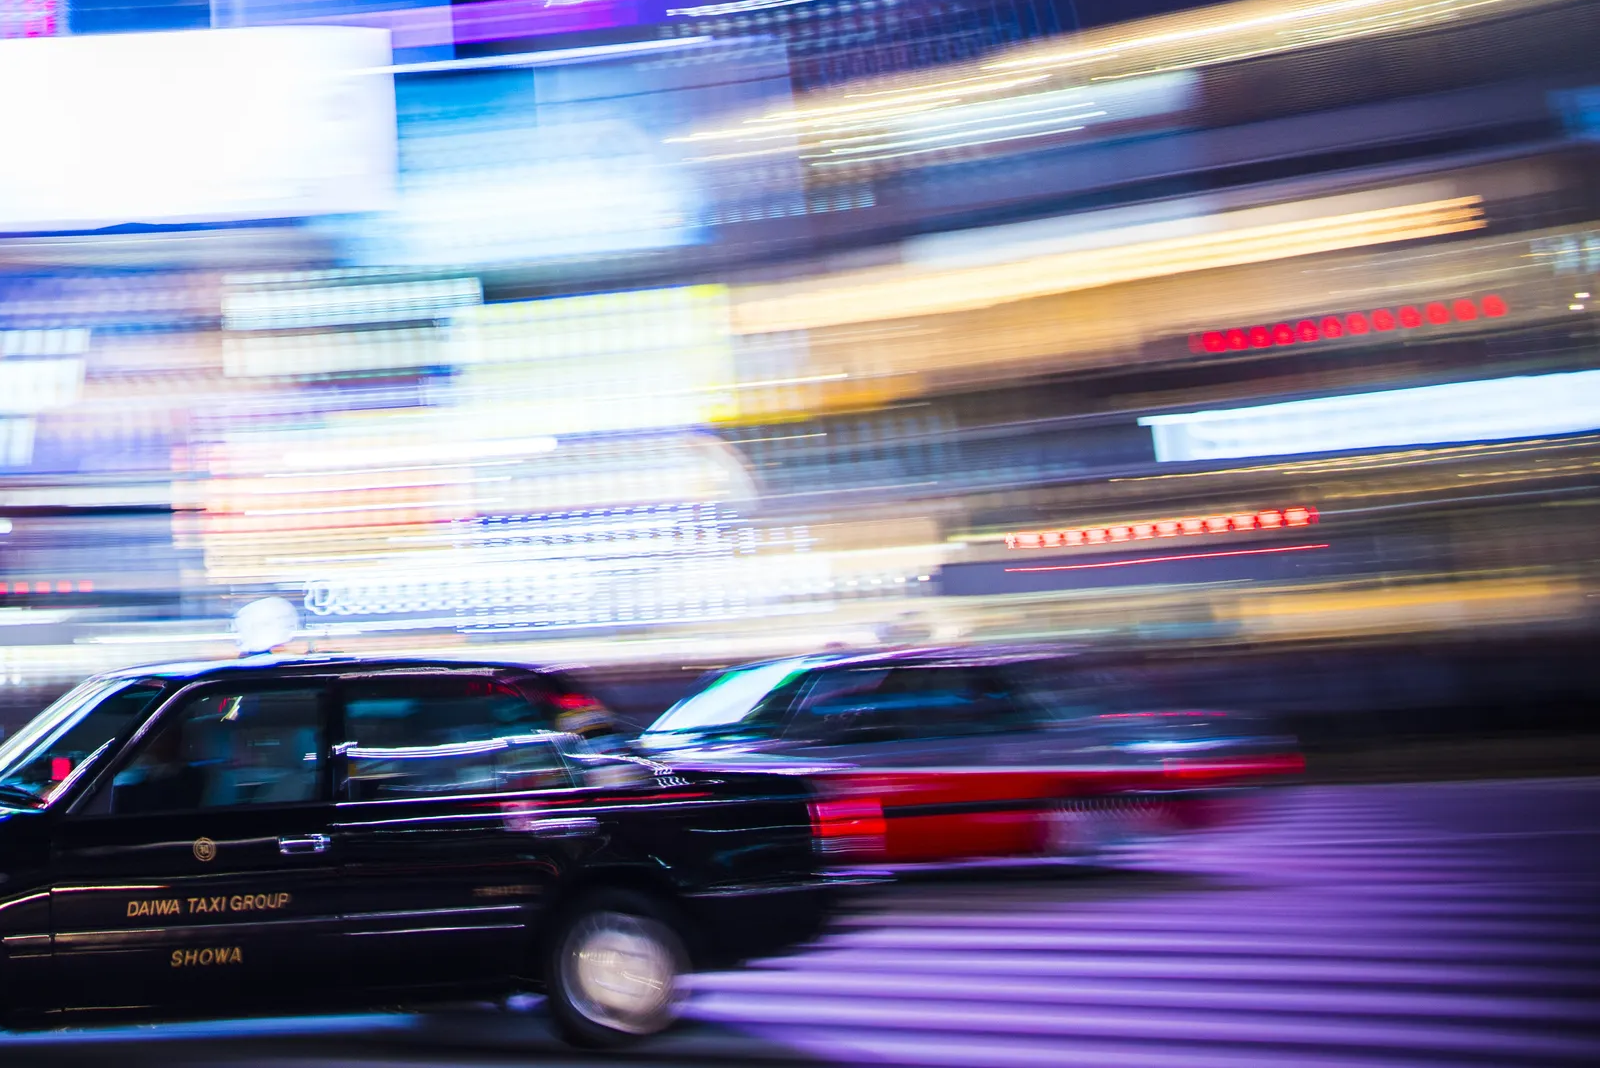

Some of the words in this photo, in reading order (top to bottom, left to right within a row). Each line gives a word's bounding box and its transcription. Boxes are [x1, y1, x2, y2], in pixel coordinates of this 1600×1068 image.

[126, 898, 181, 917] DAIWA
[187, 896, 227, 914] TAXI
[230, 892, 290, 912] GROUP
[170, 946, 243, 968] SHOWA
